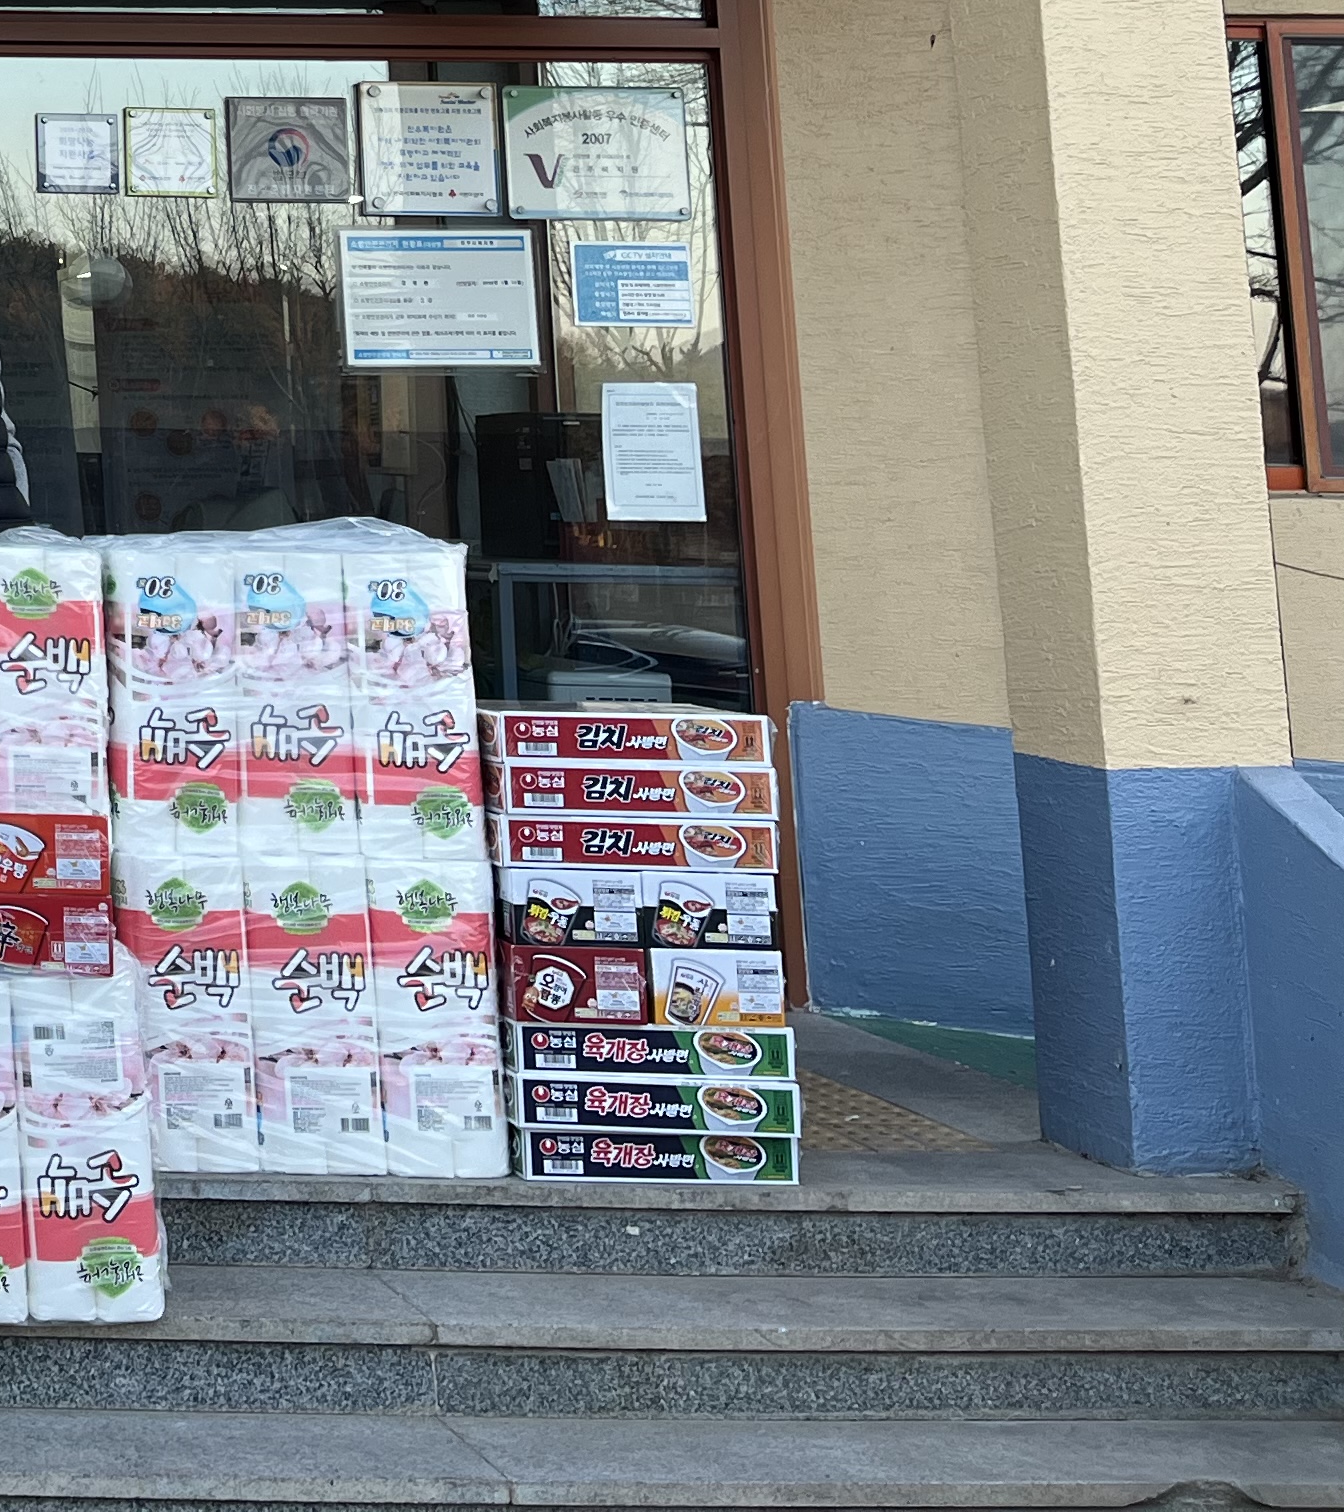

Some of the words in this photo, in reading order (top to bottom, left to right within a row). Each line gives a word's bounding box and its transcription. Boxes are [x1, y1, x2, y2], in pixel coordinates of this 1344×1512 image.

[582, 133, 612, 145] 2007
[1, 578, 62, 599] 행복나무
[0, 631, 91, 695] 순백
[532, 725, 558, 737] 농심
[575, 724, 627, 751] 김치
[626, 735, 669, 750] 사발면
[538, 776, 565, 788] 농심
[582, 775, 634, 803] 김치
[633, 787, 676, 802] 사발면
[536, 829, 563, 842] 농심
[581, 829, 634, 857] 김치
[632, 842, 676, 856] 사발면
[145, 889, 207, 913] 행복나무
[271, 892, 333, 915] 행복나무
[396, 888, 457, 913] 행복나무
[148, 944, 240, 1010] 순백
[272, 947, 366, 1013] 순백
[397, 945, 488, 1012] 순백
[549, 1036, 577, 1048] 농심
[583, 1033, 648, 1063] 육개장
[647, 1048, 690, 1063] 사발면
[551, 1089, 578, 1102] 농심
[585, 1086, 652, 1117] 육개장
[650, 1103, 693, 1118] 사발면
[557, 1141, 585, 1154] 농심
[590, 1138, 656, 1168] 육개장
[654, 1153, 695, 1168] 사발면
